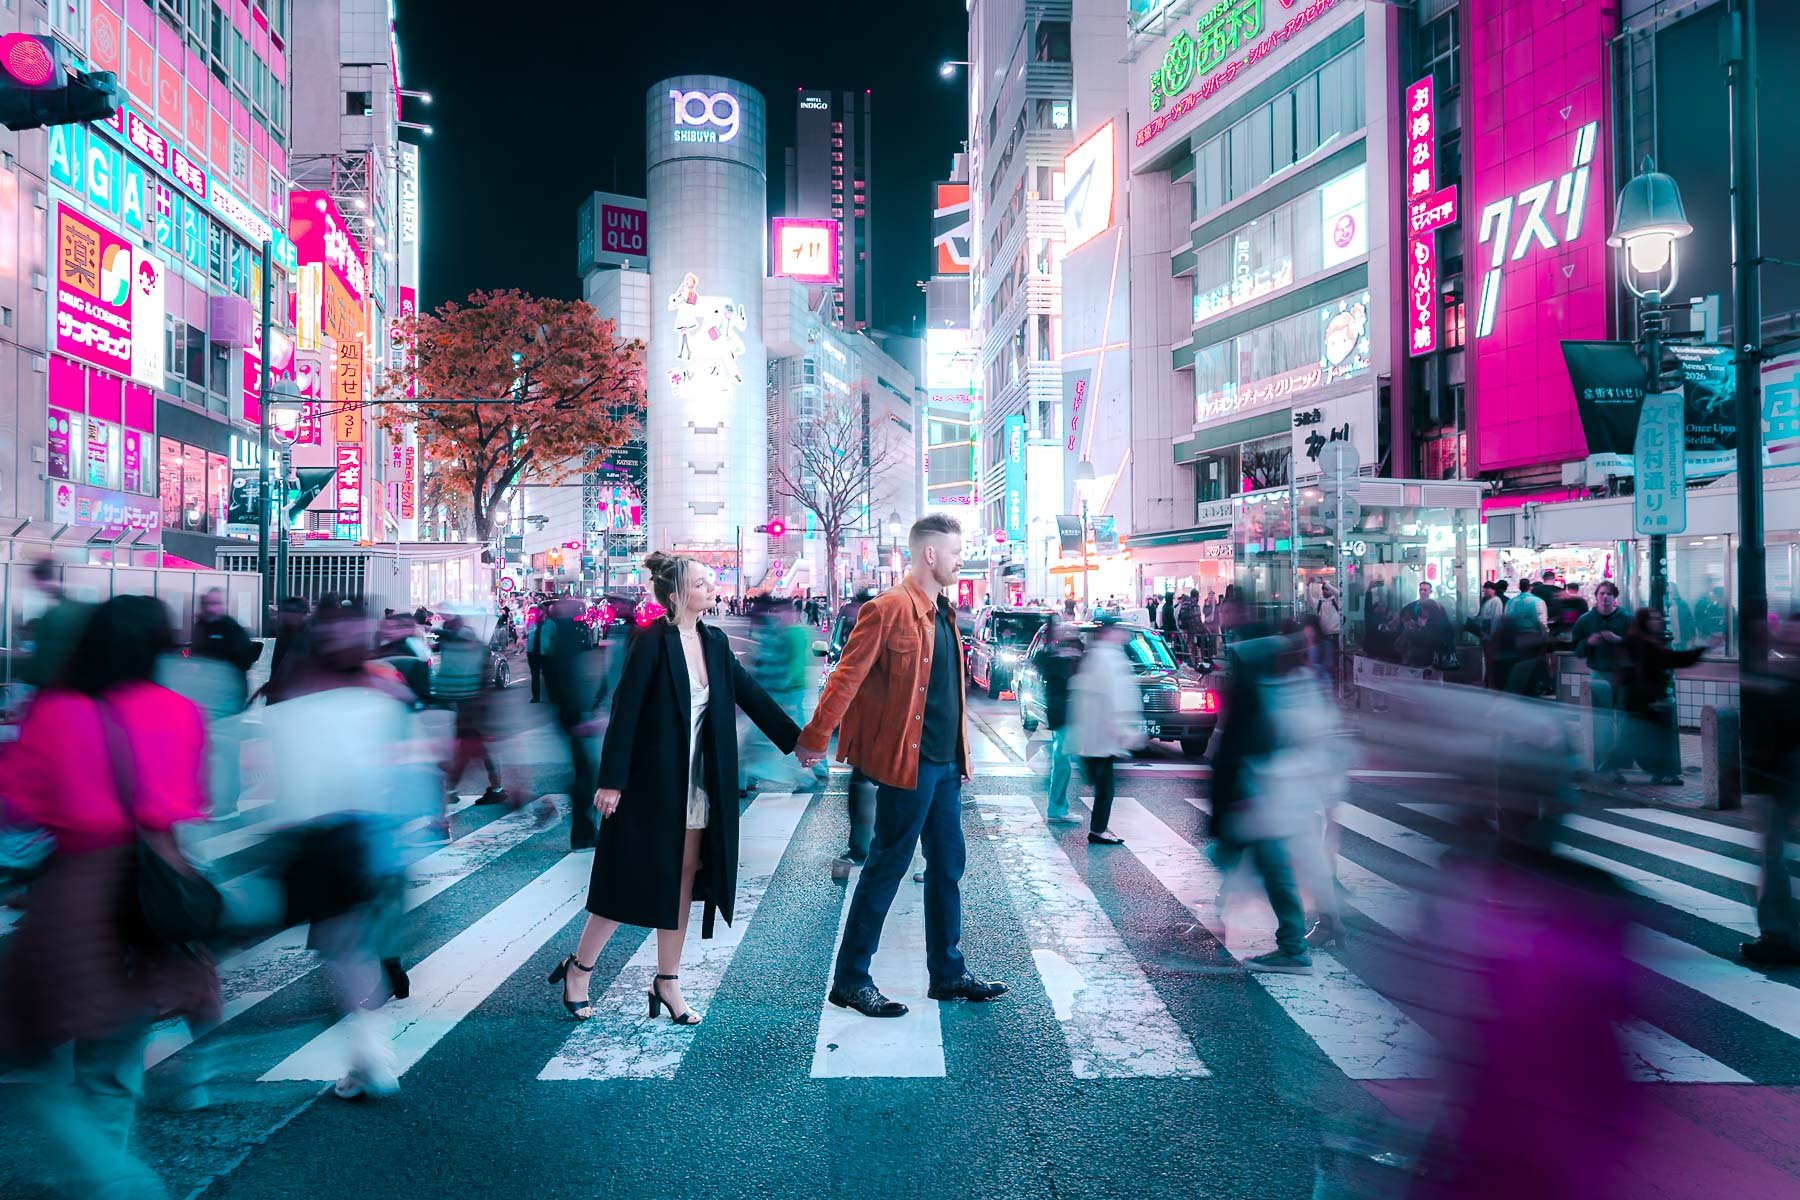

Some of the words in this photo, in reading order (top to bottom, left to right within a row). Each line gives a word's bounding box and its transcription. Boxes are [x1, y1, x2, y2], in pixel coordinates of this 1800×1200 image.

[800, 102, 828, 110] INDIGO
[669, 89, 740, 143] 109
[674, 130, 716, 143] SHIBUYA
[607, 211, 639, 232] UNI
[607, 230, 642, 249] QLO
[58, 310, 132, 361] サンドラッグ
[1682, 361, 1706, 371] Arena
[1705, 363, 1726, 372] Tour
[1684, 372, 1707, 380] 2026
[1685, 423, 1712, 433] Once
[103, 503, 159, 529] サンドラッグ
